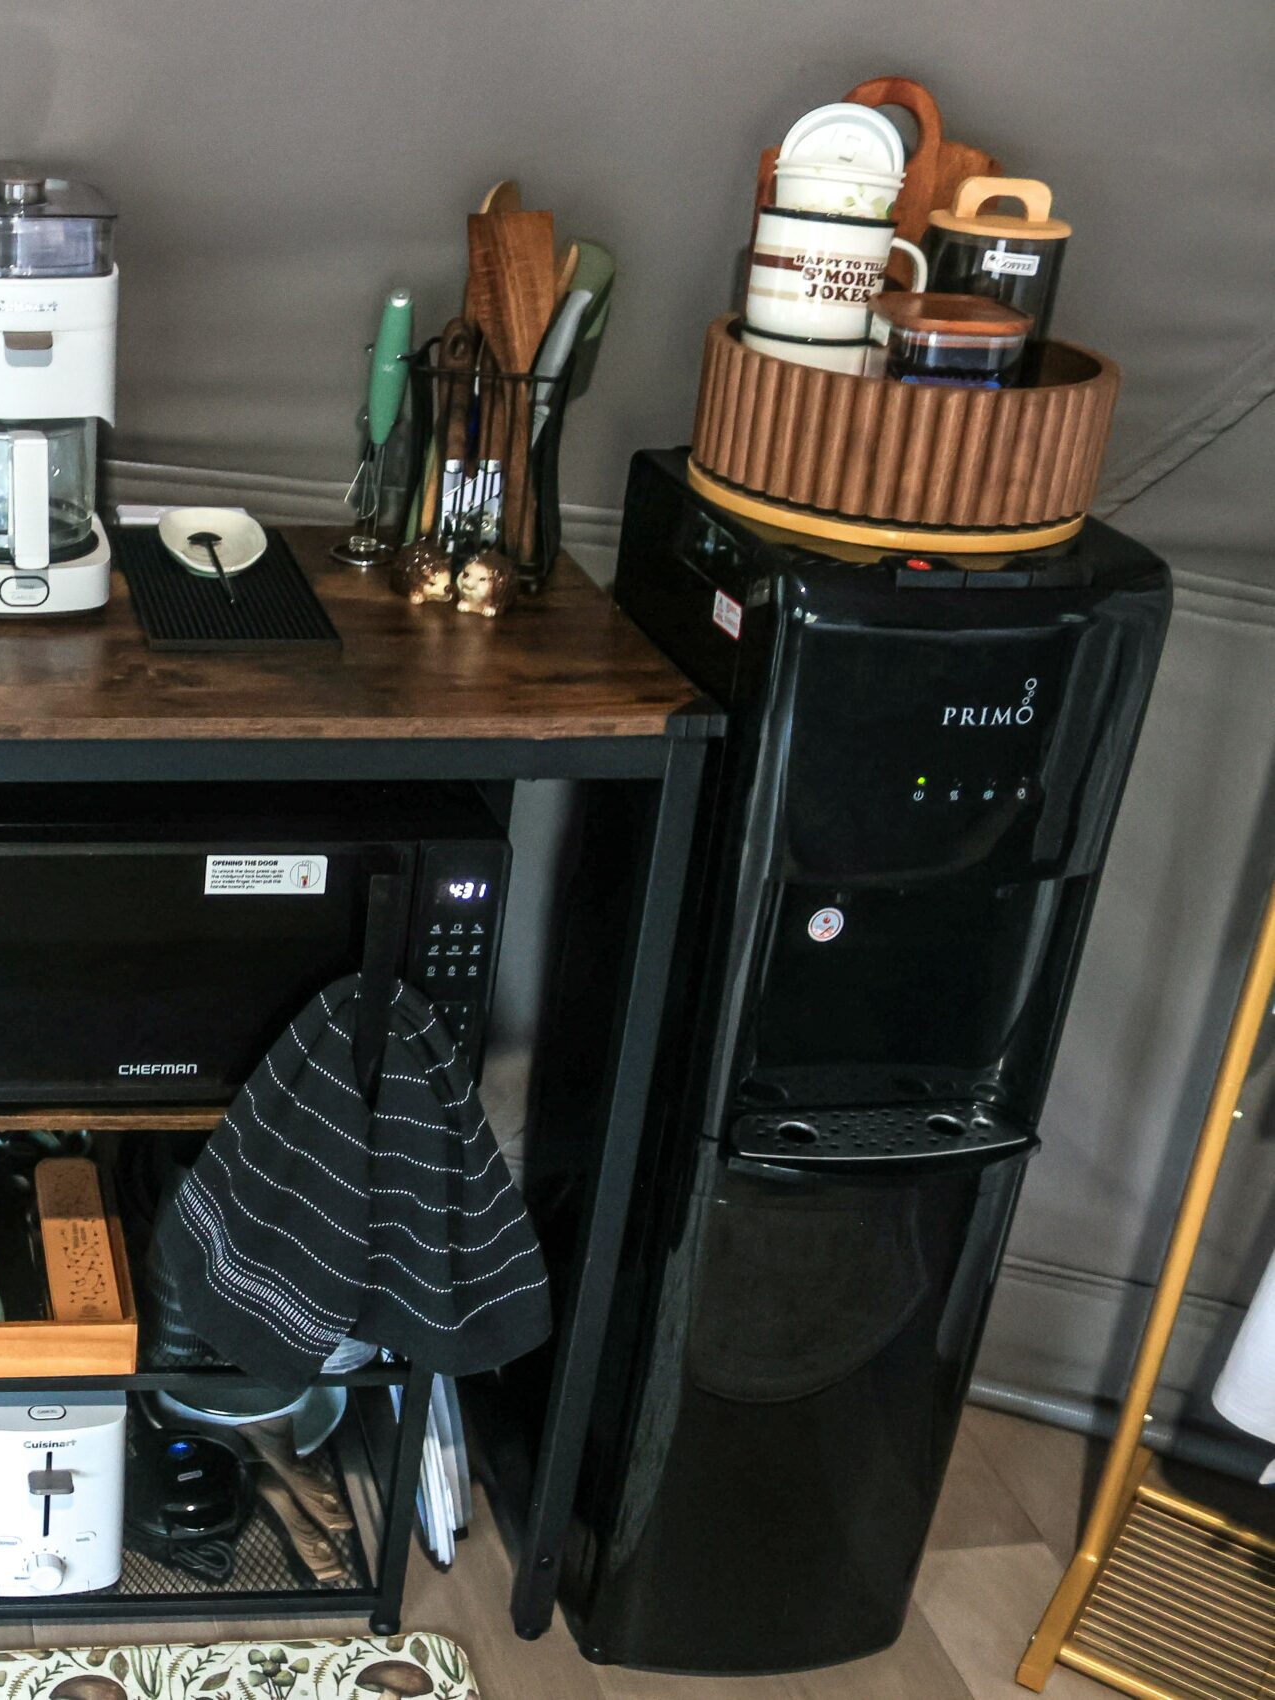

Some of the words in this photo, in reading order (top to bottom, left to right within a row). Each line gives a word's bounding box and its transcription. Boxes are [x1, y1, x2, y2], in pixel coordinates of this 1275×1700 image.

[797, 254, 842, 268] HAPPY
[845, 260, 862, 270] TO
[803, 266, 876, 288] S'MORE
[805, 283, 872, 303] JOKES
[941, 704, 1034, 726] PRIMO
[117, 1063, 198, 1076] CHEFMAN
[22, 1439, 78, 1449] Cuisinart
